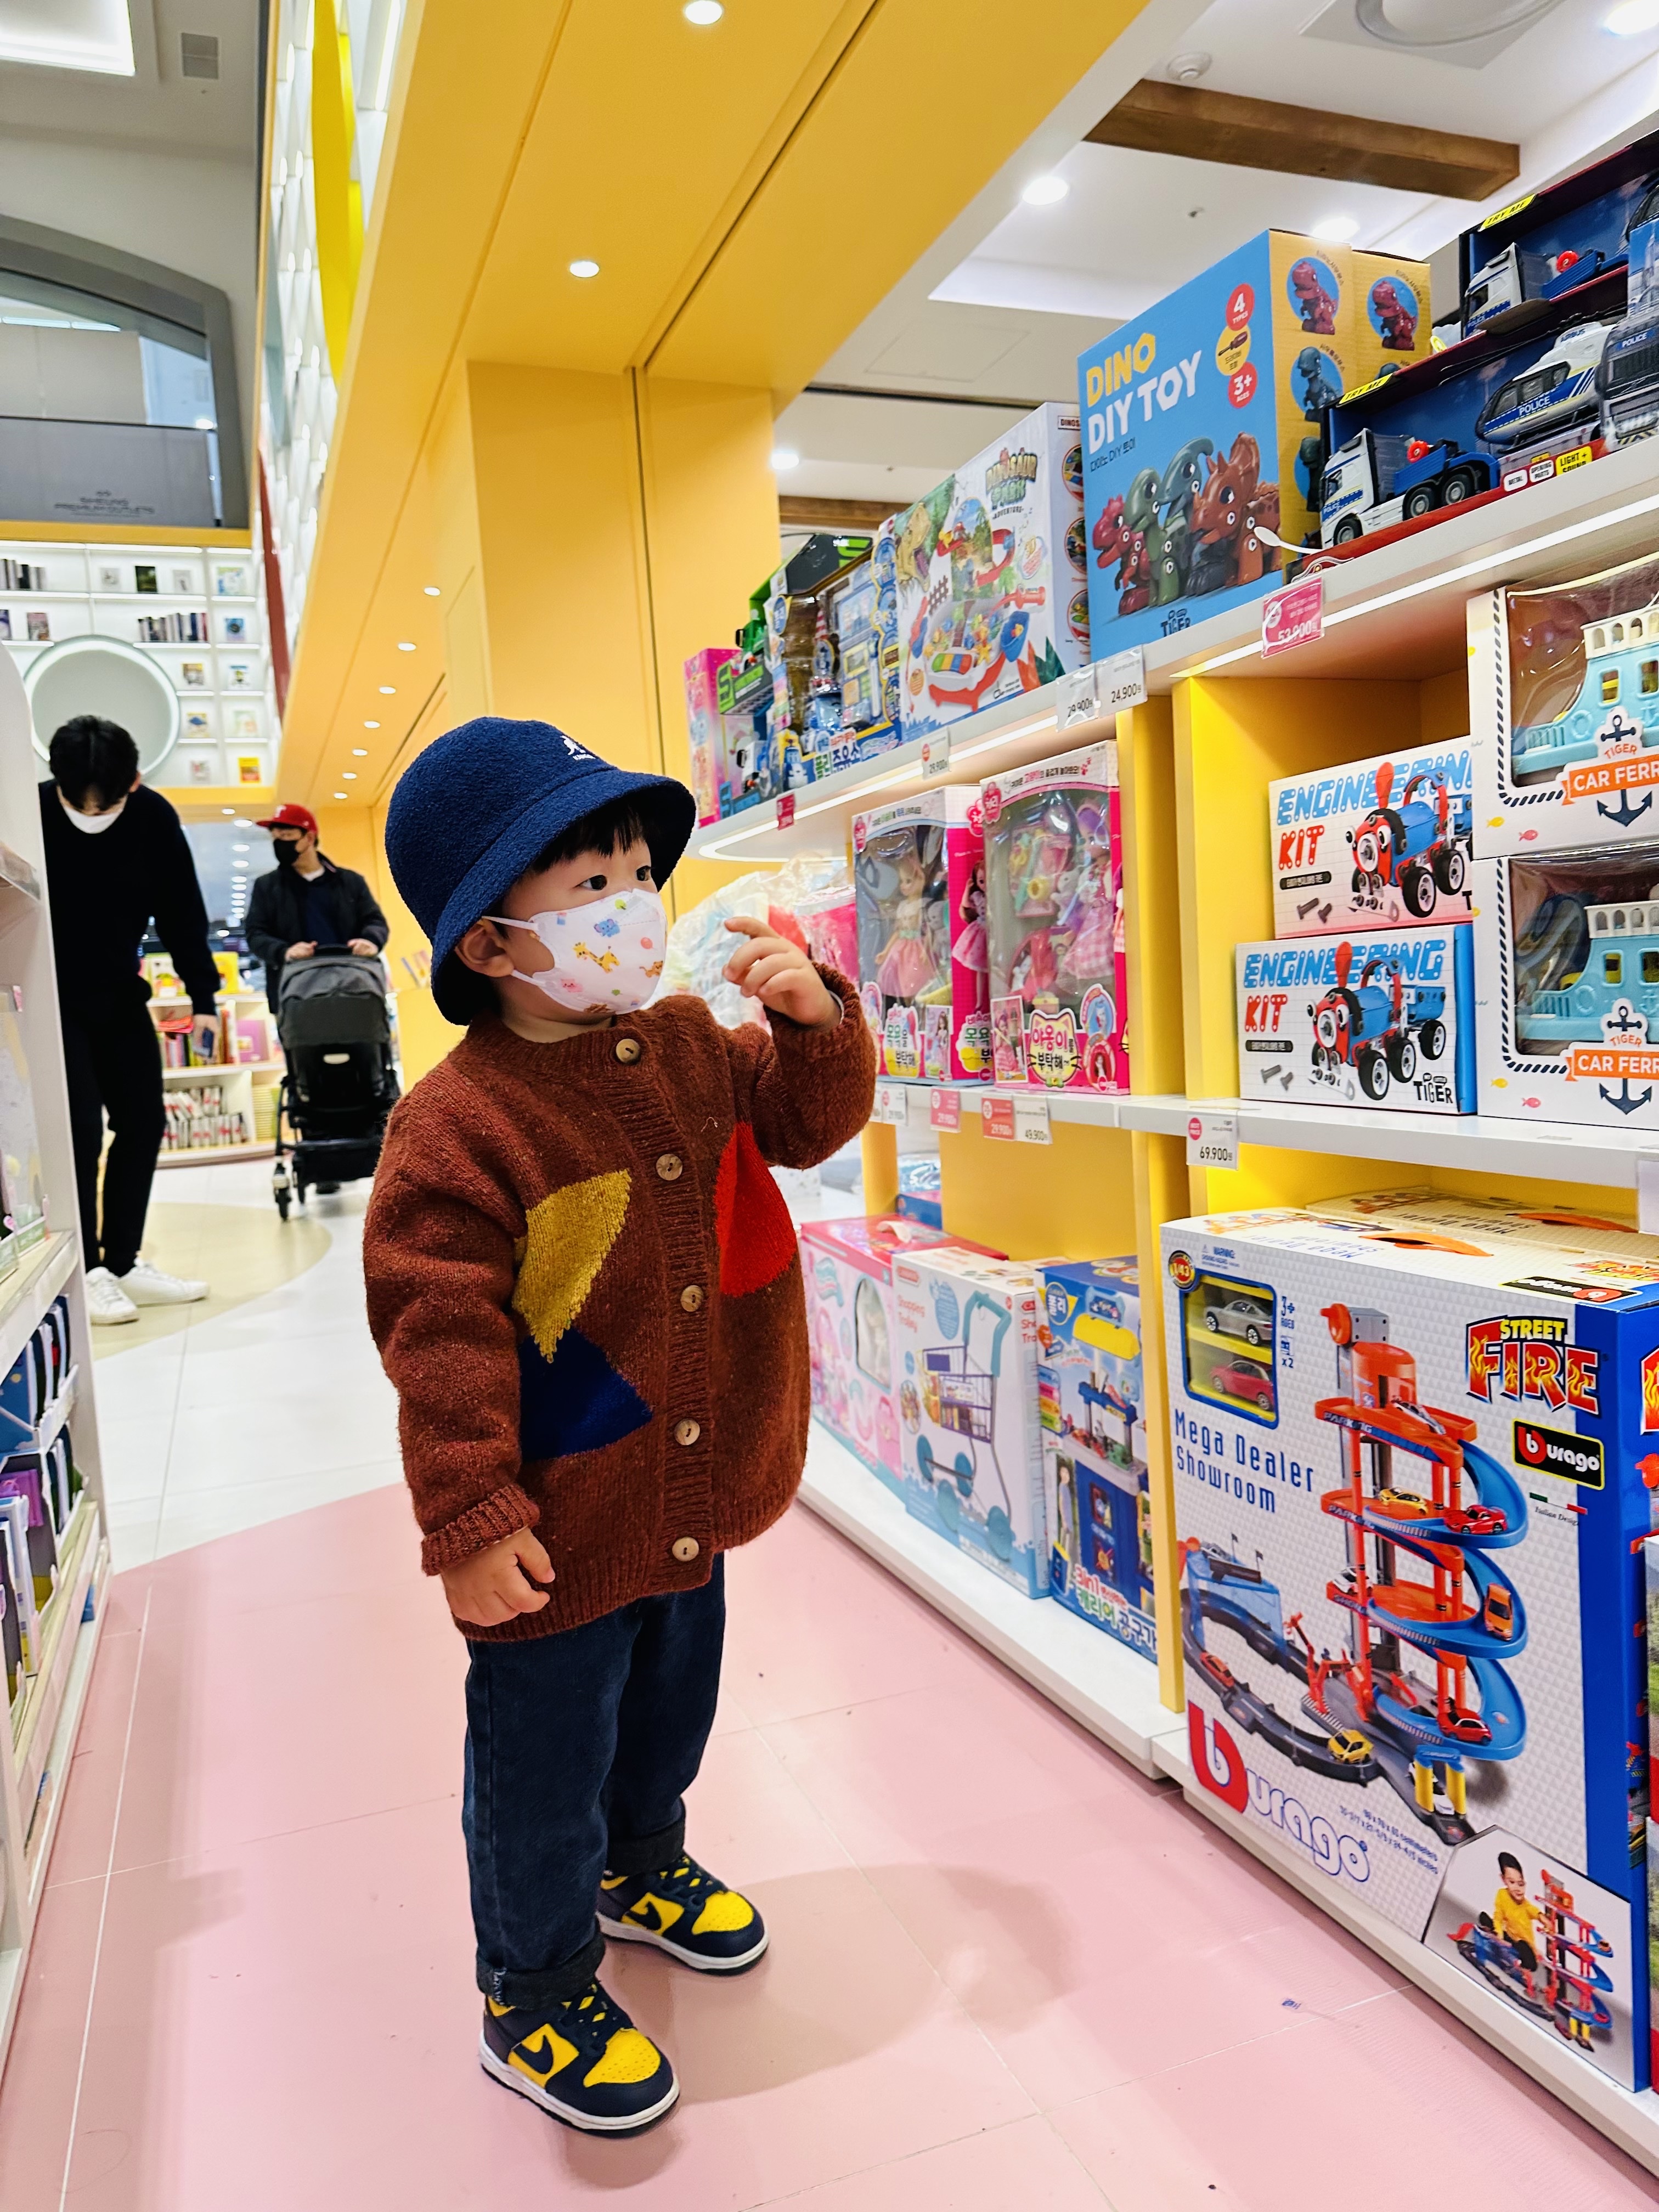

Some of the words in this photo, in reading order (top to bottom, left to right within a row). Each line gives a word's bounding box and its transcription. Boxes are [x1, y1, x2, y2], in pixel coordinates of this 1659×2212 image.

[1233, 292, 1246, 313] 4
[1622, 331, 1647, 348] POLICE
[1086, 332, 1156, 408] DINO
[1234, 374, 1253, 396] 3+
[1345, 388, 1363, 400] TRY
[1365, 379, 1384, 391] ME
[1088, 391, 1134, 455] DIY
[1137, 349, 1202, 422] TOY
[1519, 396, 1551, 416] POLICE
[1560, 453, 1579, 467] LIGHT
[1604, 743, 1638, 760] TIGER
[1573, 770, 1610, 792] CAR
[1278, 825, 1325, 871] KIT
[1244, 994, 1288, 1032] KIT
[1610, 1034, 1642, 1047] TIGER
[1577, 1054, 1613, 1072] CAR
[1413, 1081, 1453, 1104] TIGER
[1281, 1295, 1295, 1316] 3+
[1499, 1319, 1565, 1341] STREET
[1466, 1319, 1599, 1415] FIRE
[1175, 1408, 1224, 1458] Mega
[1236, 1432, 1314, 1492] Dealer
[1177, 1444, 1276, 1514] Showroom
